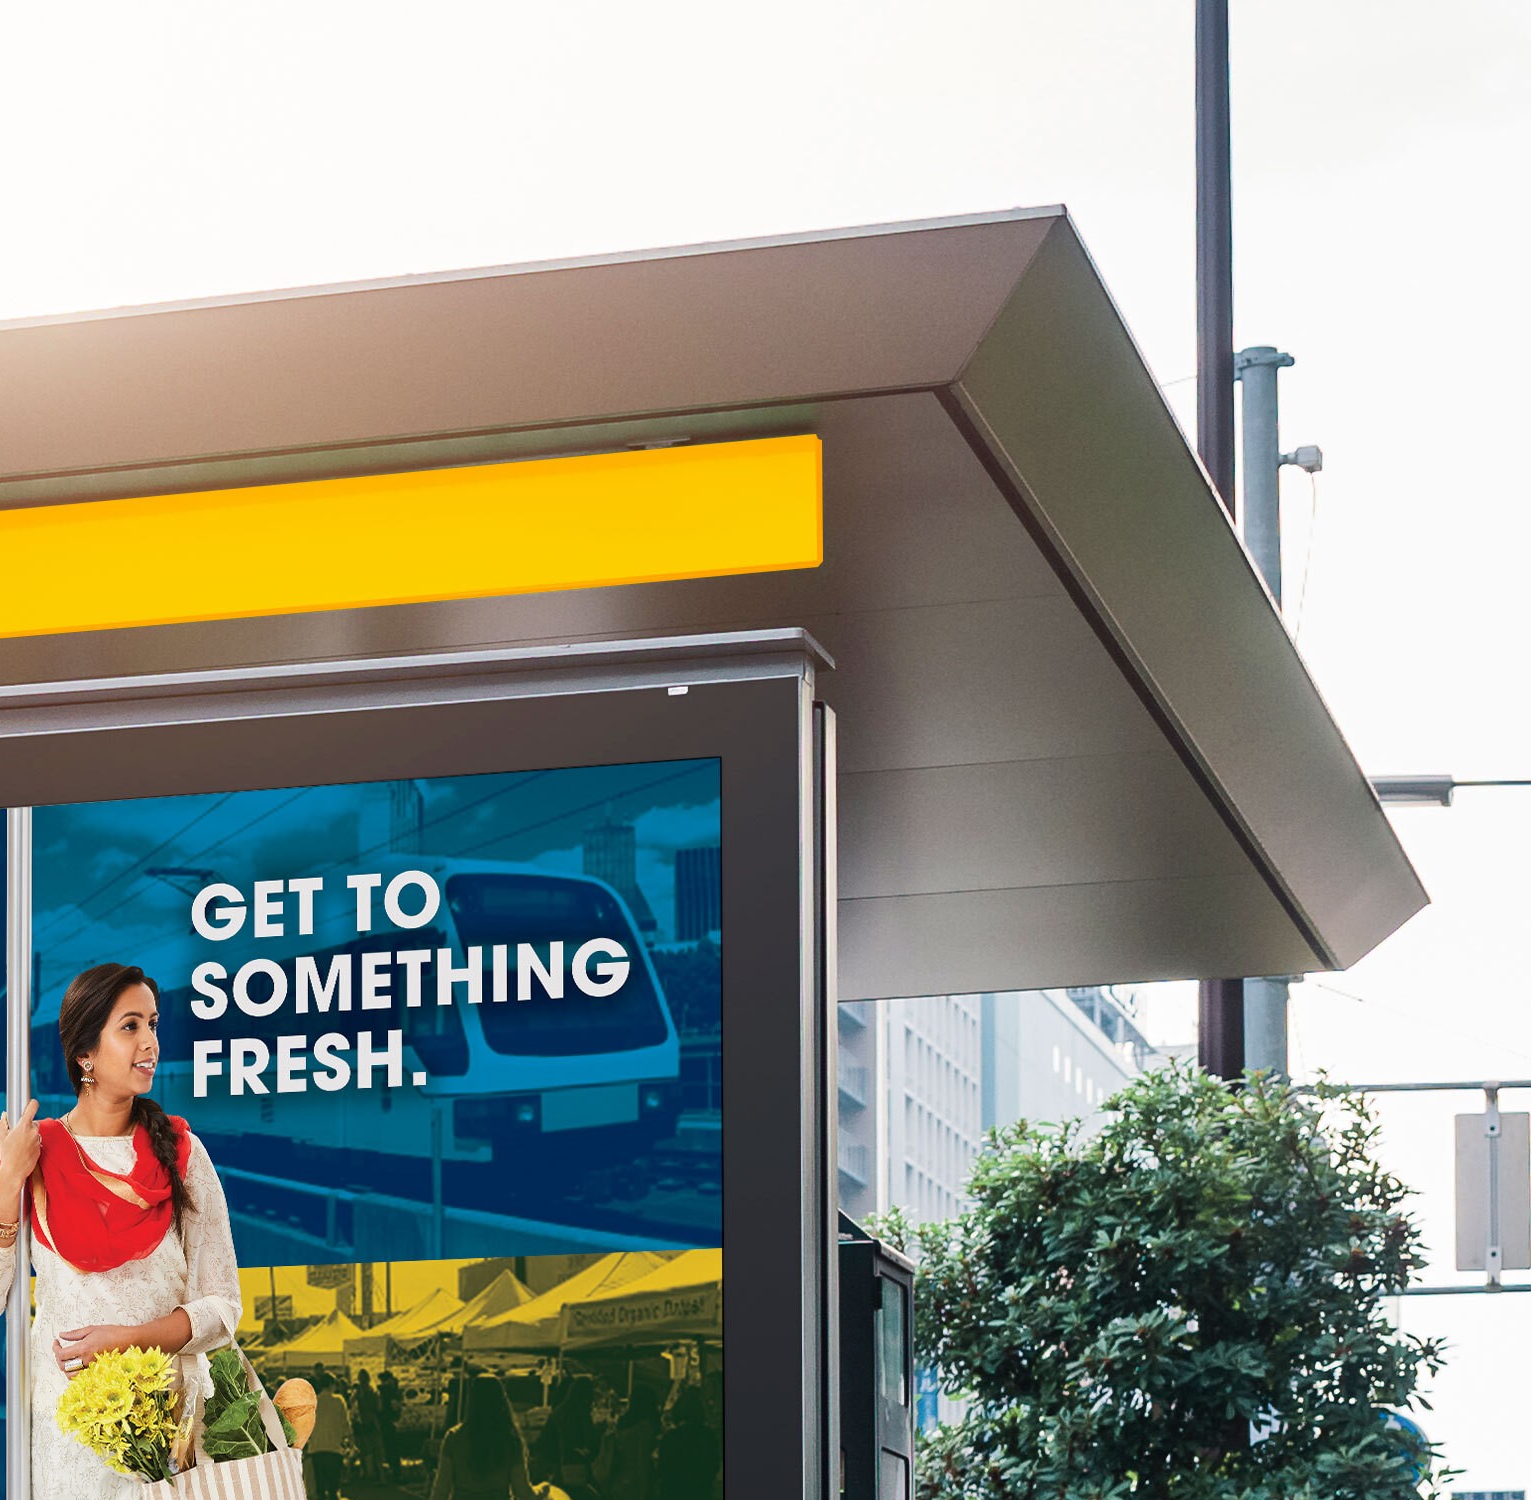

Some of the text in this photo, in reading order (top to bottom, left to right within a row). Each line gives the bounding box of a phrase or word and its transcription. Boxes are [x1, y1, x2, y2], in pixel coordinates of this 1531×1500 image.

[191, 870, 440, 941] GET TO
[190, 937, 630, 1020] SOMETHING
[193, 1029, 427, 1098] FRESH.
